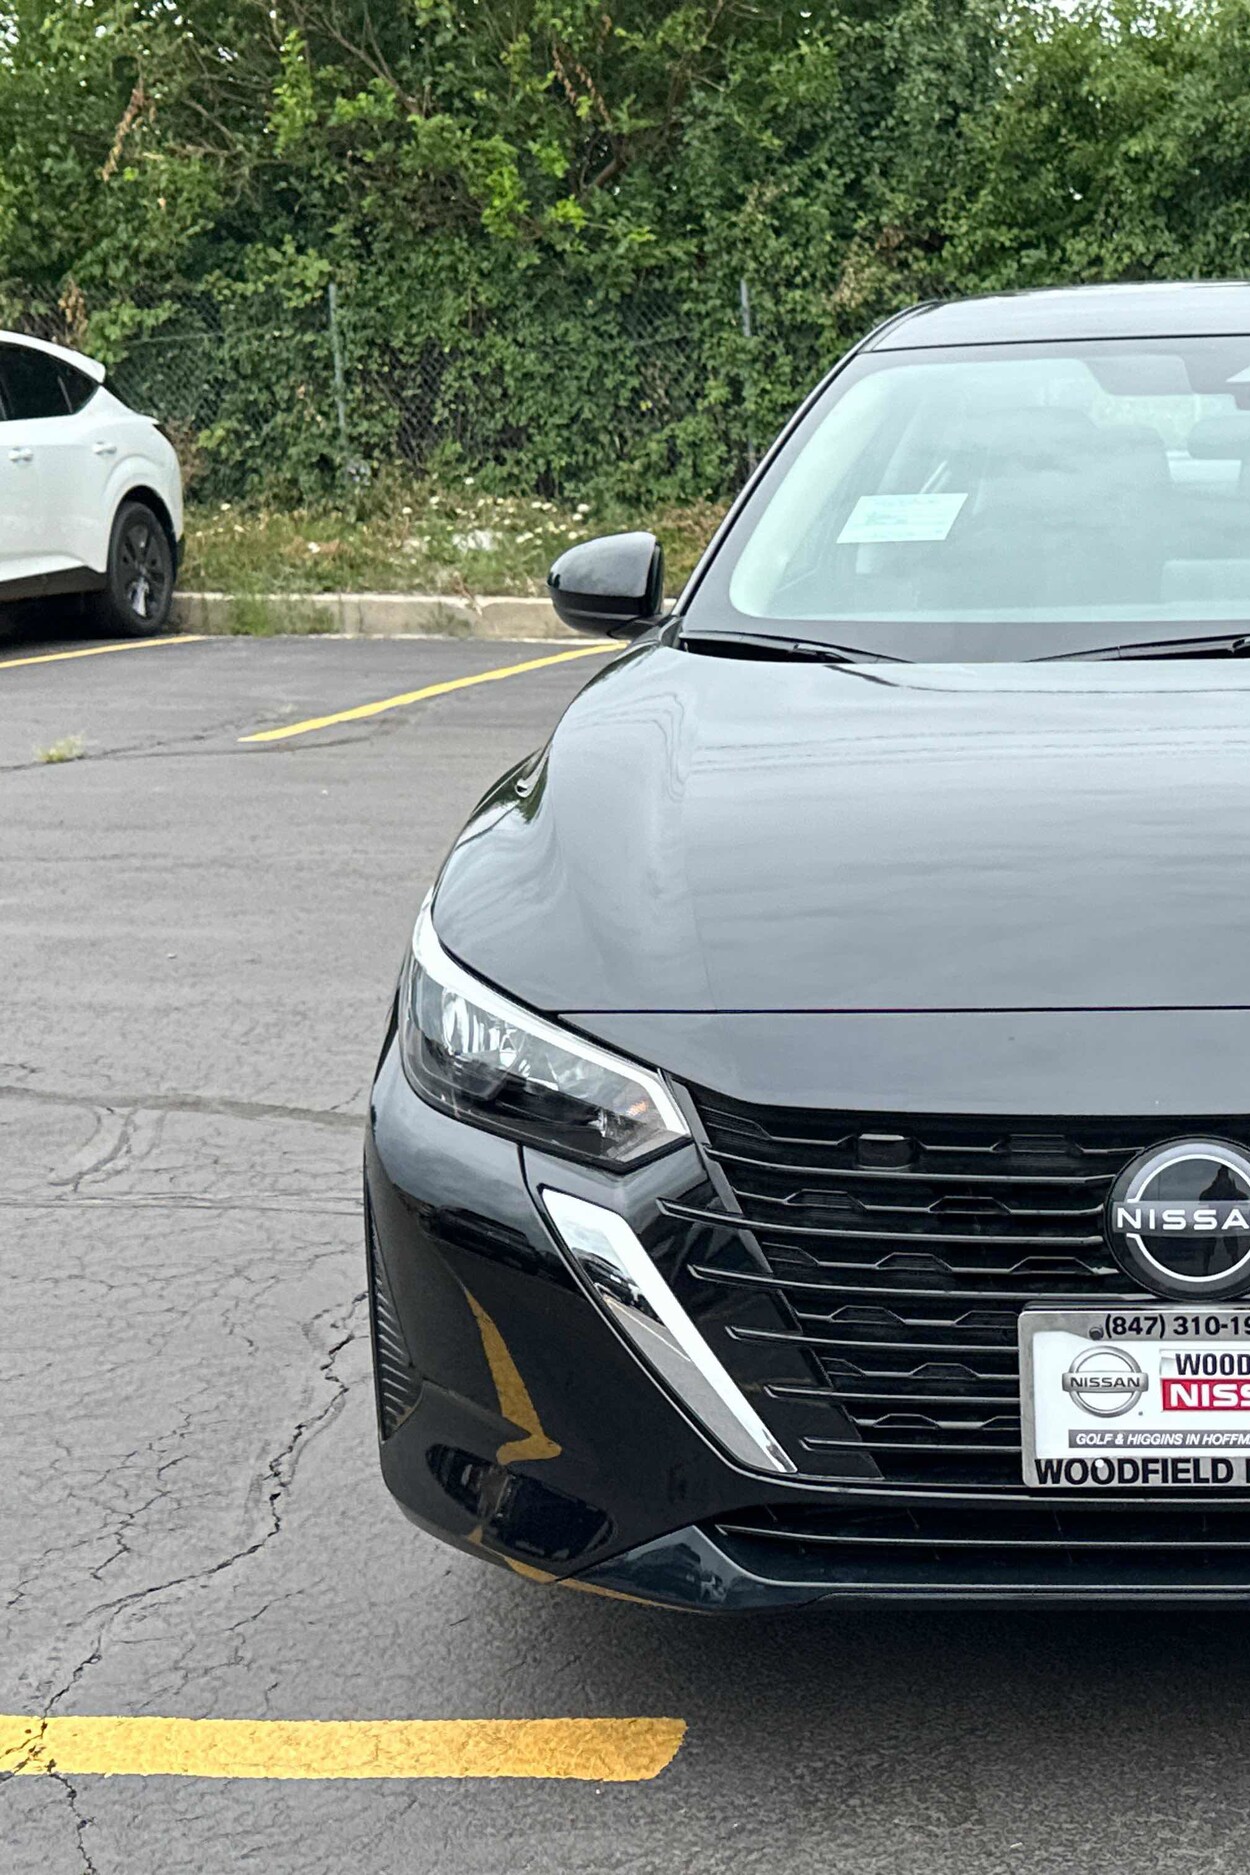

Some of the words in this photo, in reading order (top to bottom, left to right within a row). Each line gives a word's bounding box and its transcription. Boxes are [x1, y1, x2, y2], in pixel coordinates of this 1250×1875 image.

[1105, 1314, 1166, 1338] (847)
[1070, 1377, 1140, 1388] NISSAN
[1076, 1433, 1112, 1445] GOLF
[1115, 1434, 1124, 1445] &
[1127, 1433, 1183, 1445] HIGGINS
[1186, 1433, 1199, 1445] IN
[1035, 1458, 1234, 1484] WOODFIELD
